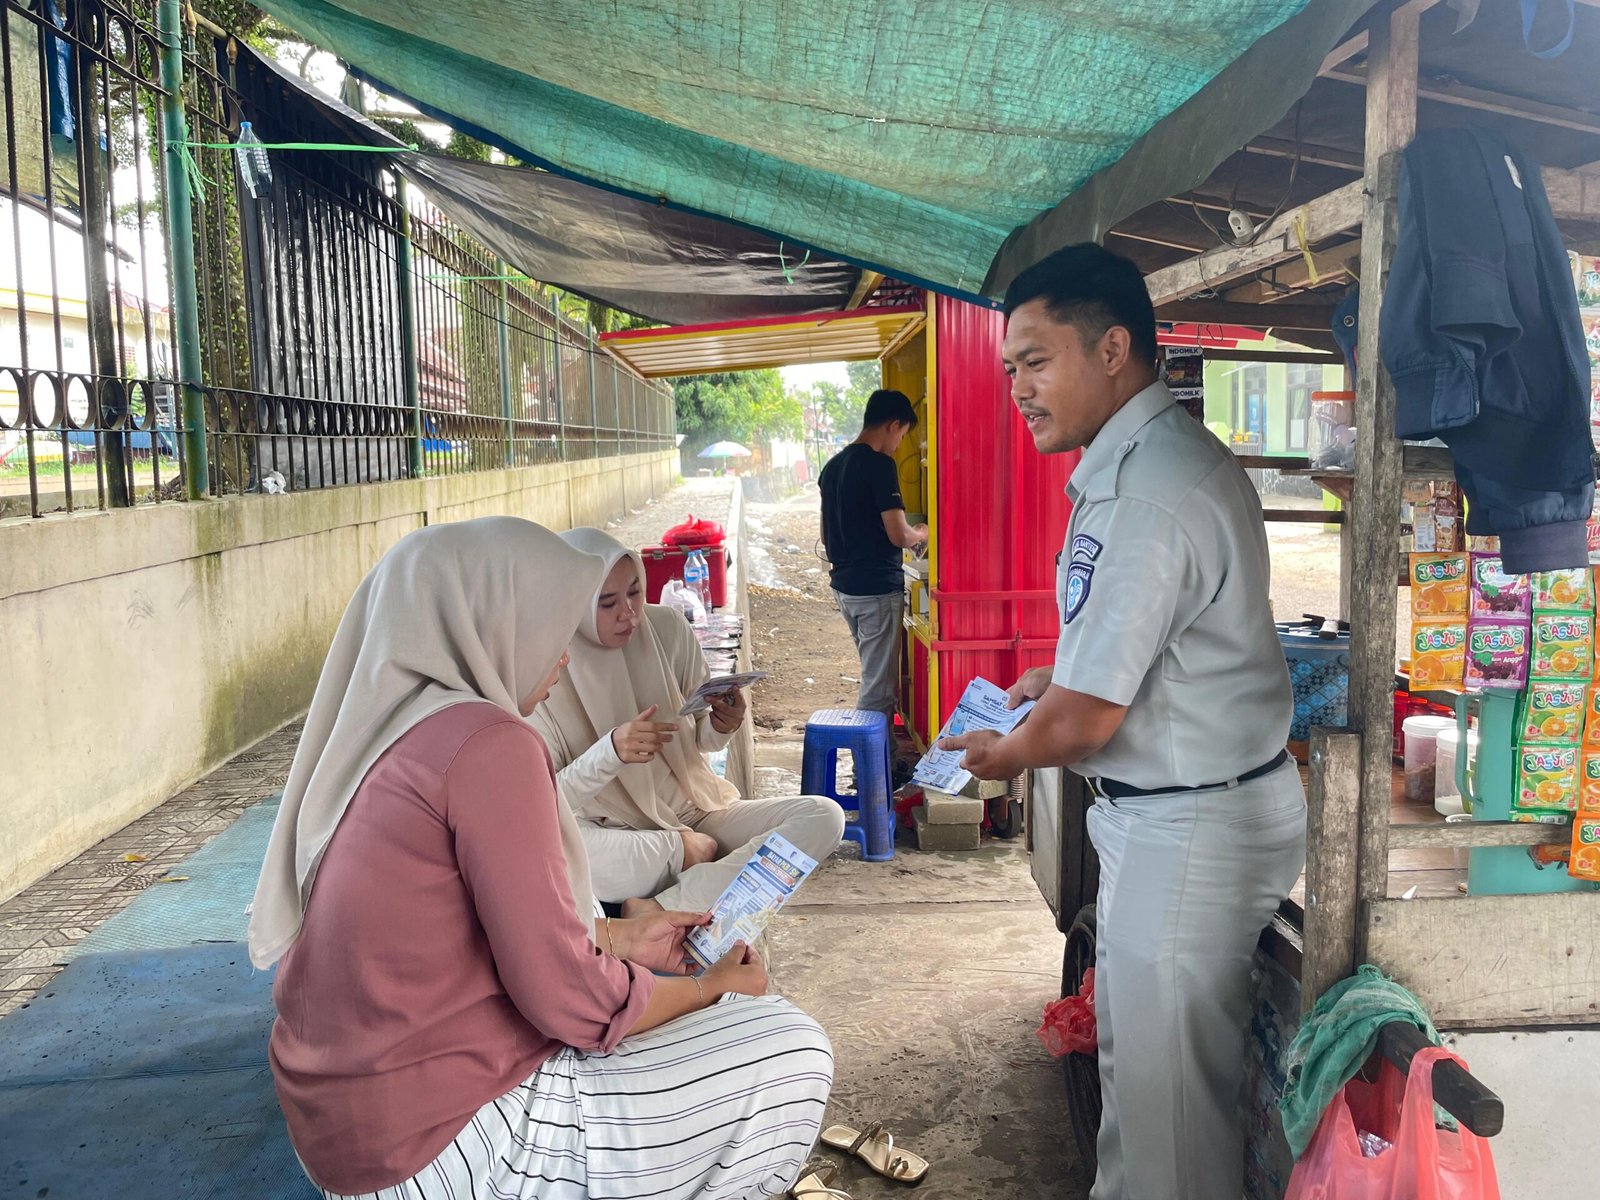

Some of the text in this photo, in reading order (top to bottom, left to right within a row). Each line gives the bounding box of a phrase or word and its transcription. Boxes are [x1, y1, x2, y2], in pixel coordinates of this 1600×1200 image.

[1418, 559, 1465, 580] JASJUS
[1418, 629, 1464, 650] JASJUS
[1474, 630, 1522, 650] JASJUS
[1541, 621, 1589, 641] JASJUS
[1537, 689, 1582, 708] JASJUS
[1526, 751, 1574, 772] JASJUS
